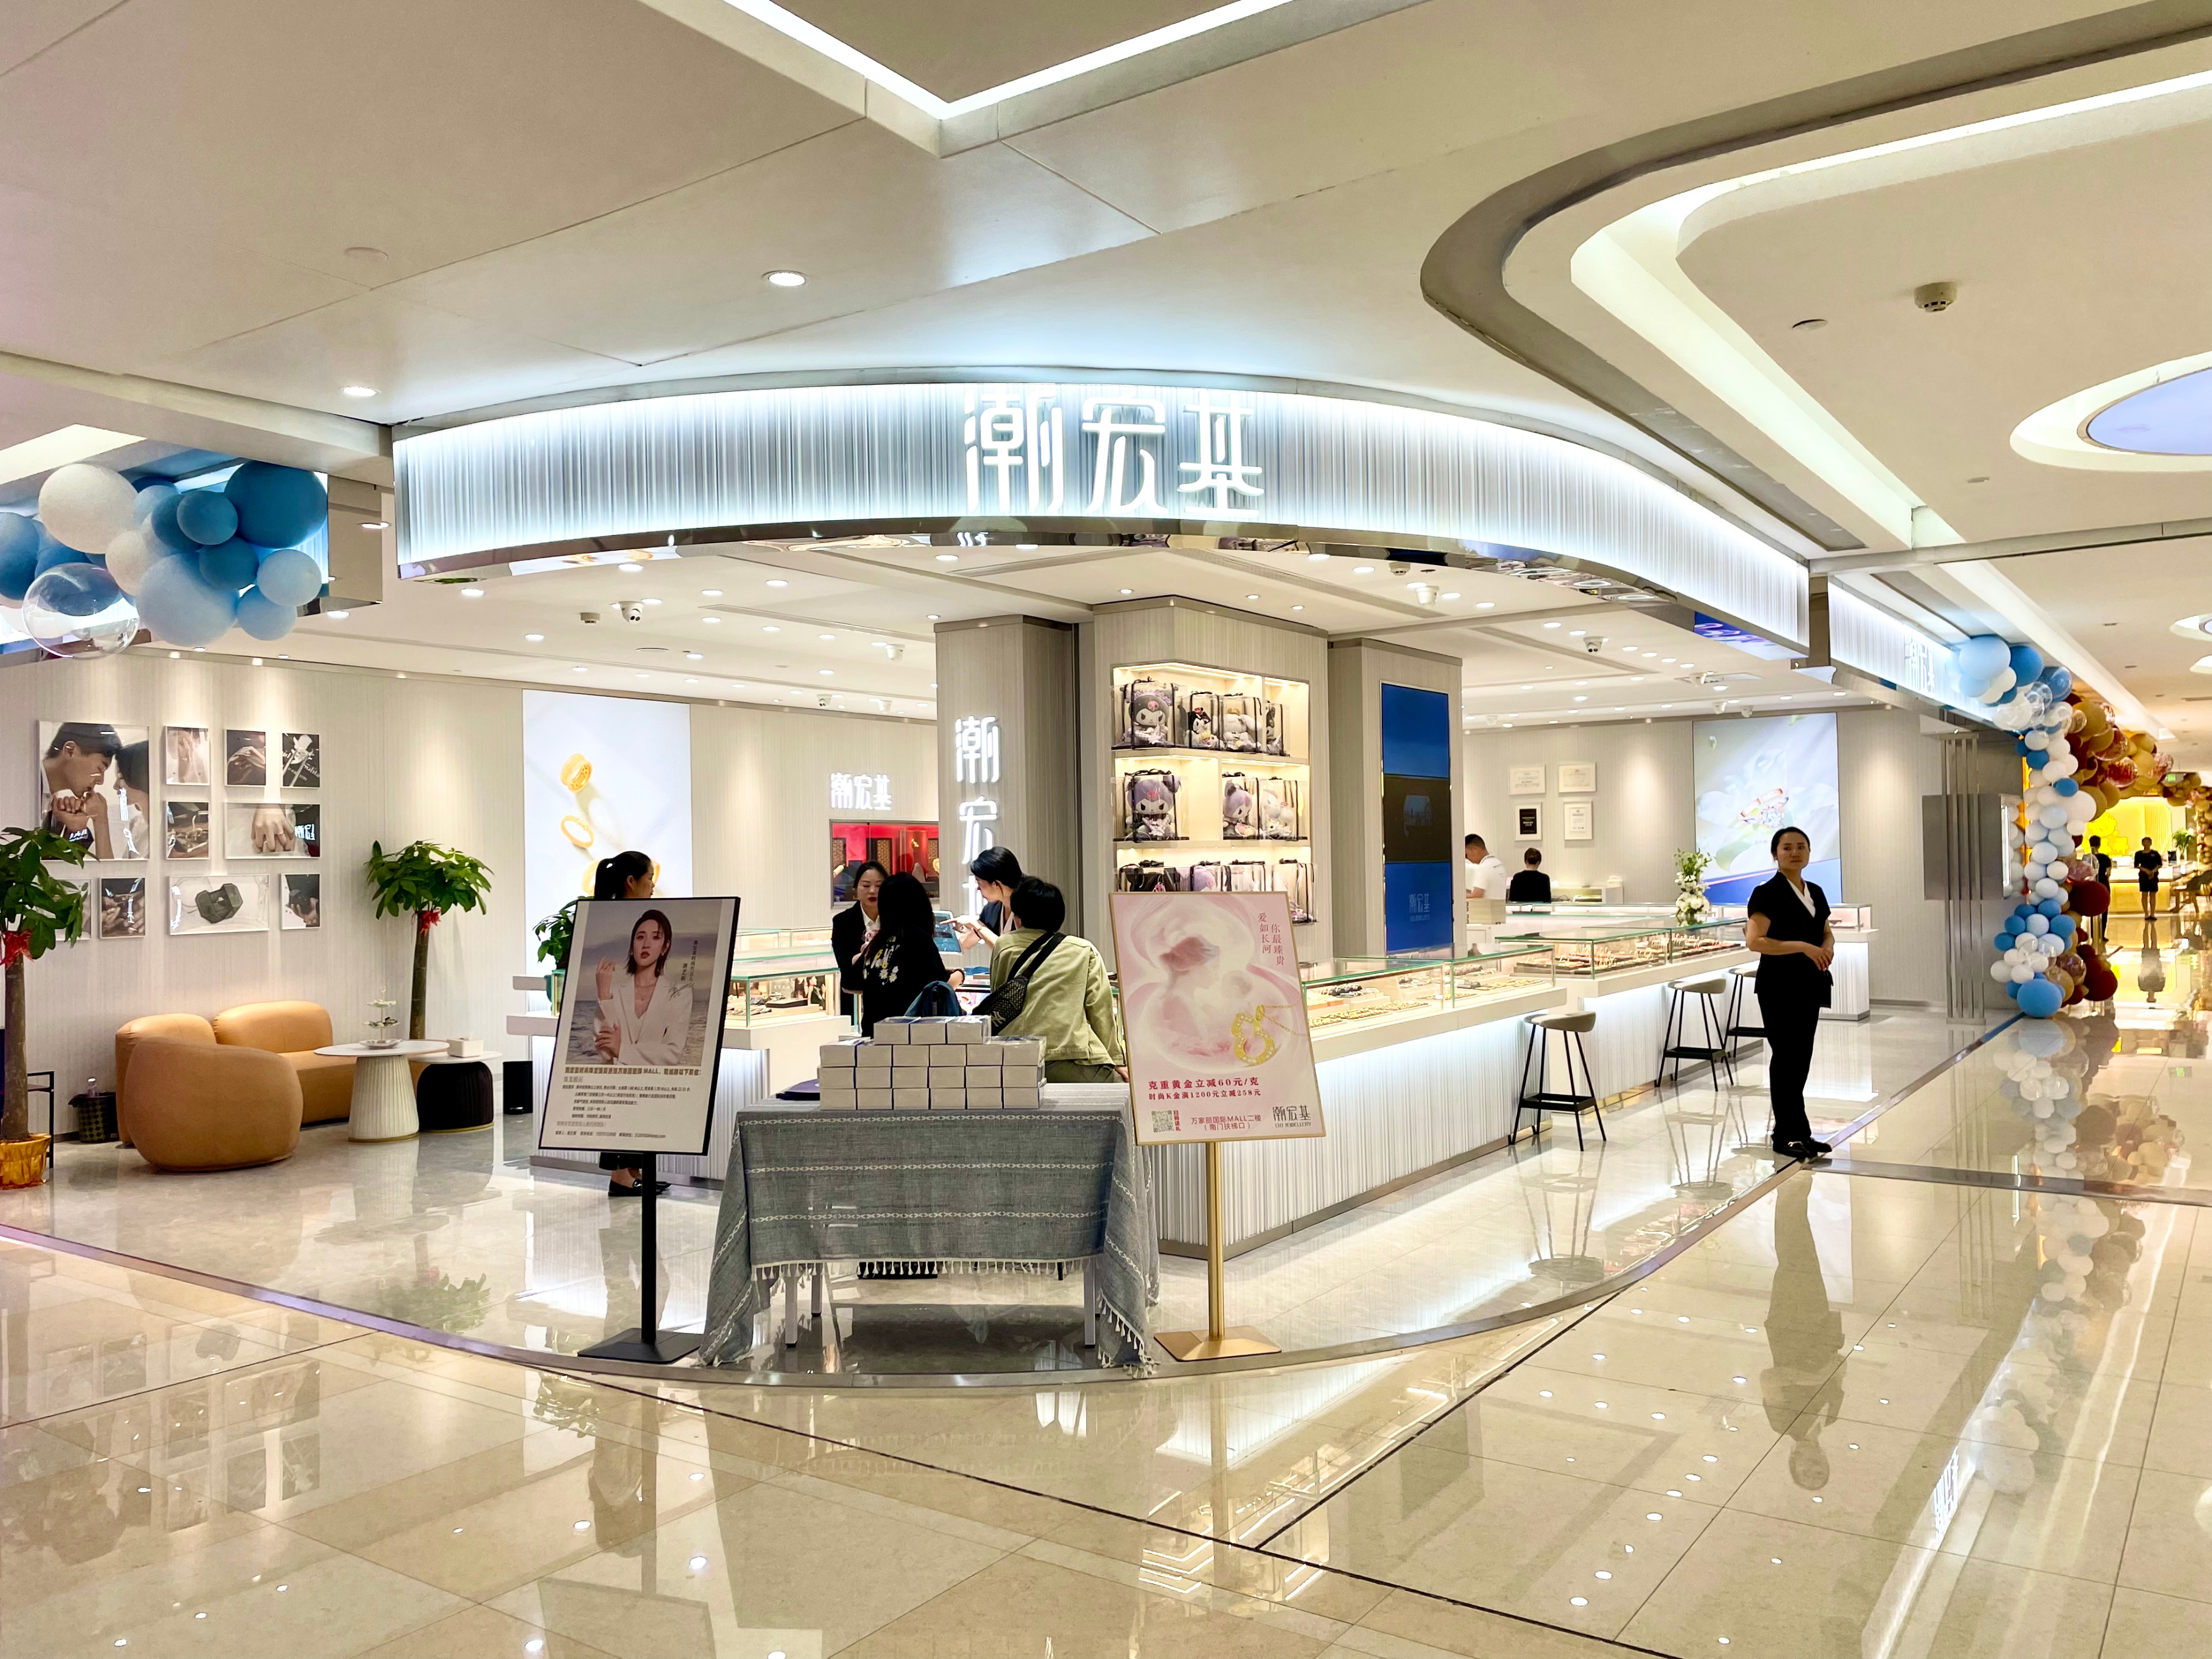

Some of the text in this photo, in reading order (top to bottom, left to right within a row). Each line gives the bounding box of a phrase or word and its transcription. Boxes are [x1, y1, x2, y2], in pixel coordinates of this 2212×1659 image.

[964, 388, 1265, 517] 潮宏基
[830, 772, 892, 811] 潮宏基
[1258, 912, 1271, 954] 爱如长河
[1148, 1077, 1259, 1090] 克重黄金立减60元/克
[1149, 1089, 1261, 1100] 时尚K金满1200元立减258元
[1273, 1105, 1311, 1121] 潮宏基
